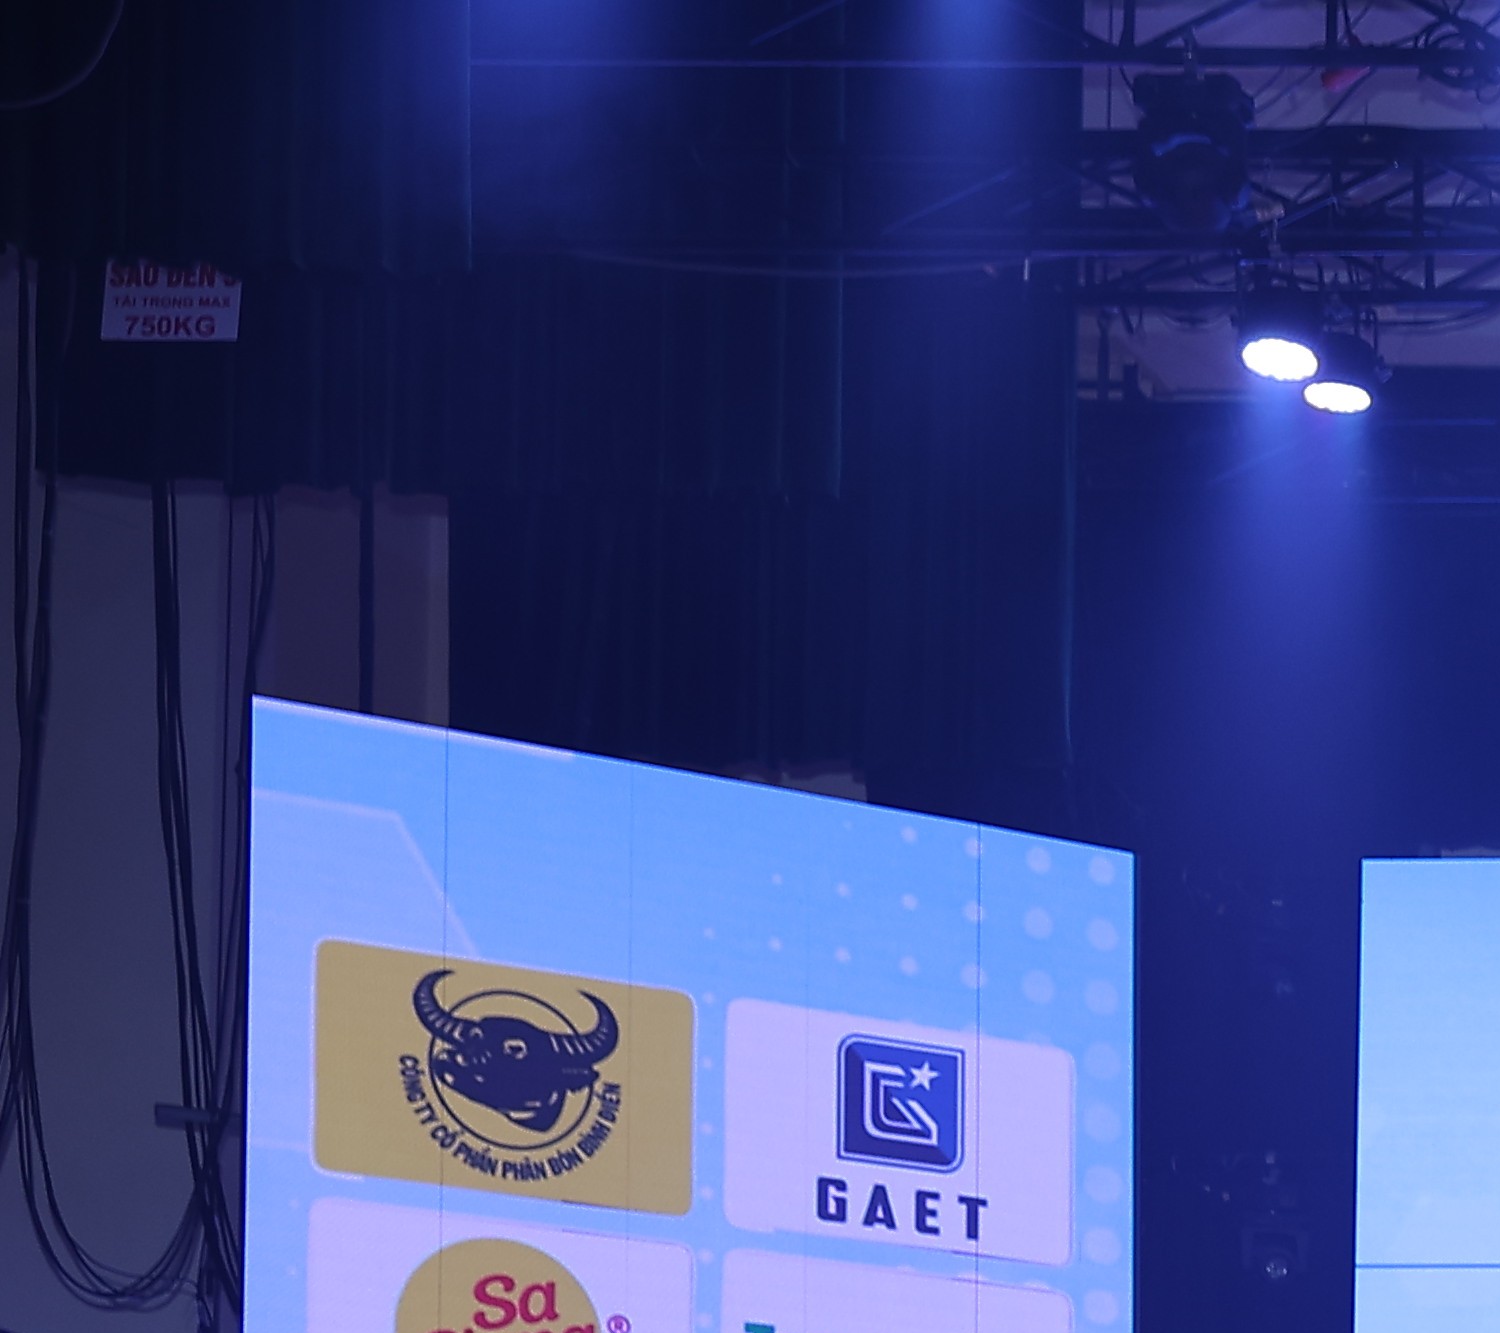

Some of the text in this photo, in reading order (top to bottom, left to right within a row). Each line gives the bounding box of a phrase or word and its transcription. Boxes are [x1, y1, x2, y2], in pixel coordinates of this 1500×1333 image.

[125, 314, 215, 337] 750KG
[414, 1102, 439, 1124] TY
[816, 1175, 988, 1240] GAET
[473, 1274, 560, 1330] Sa
